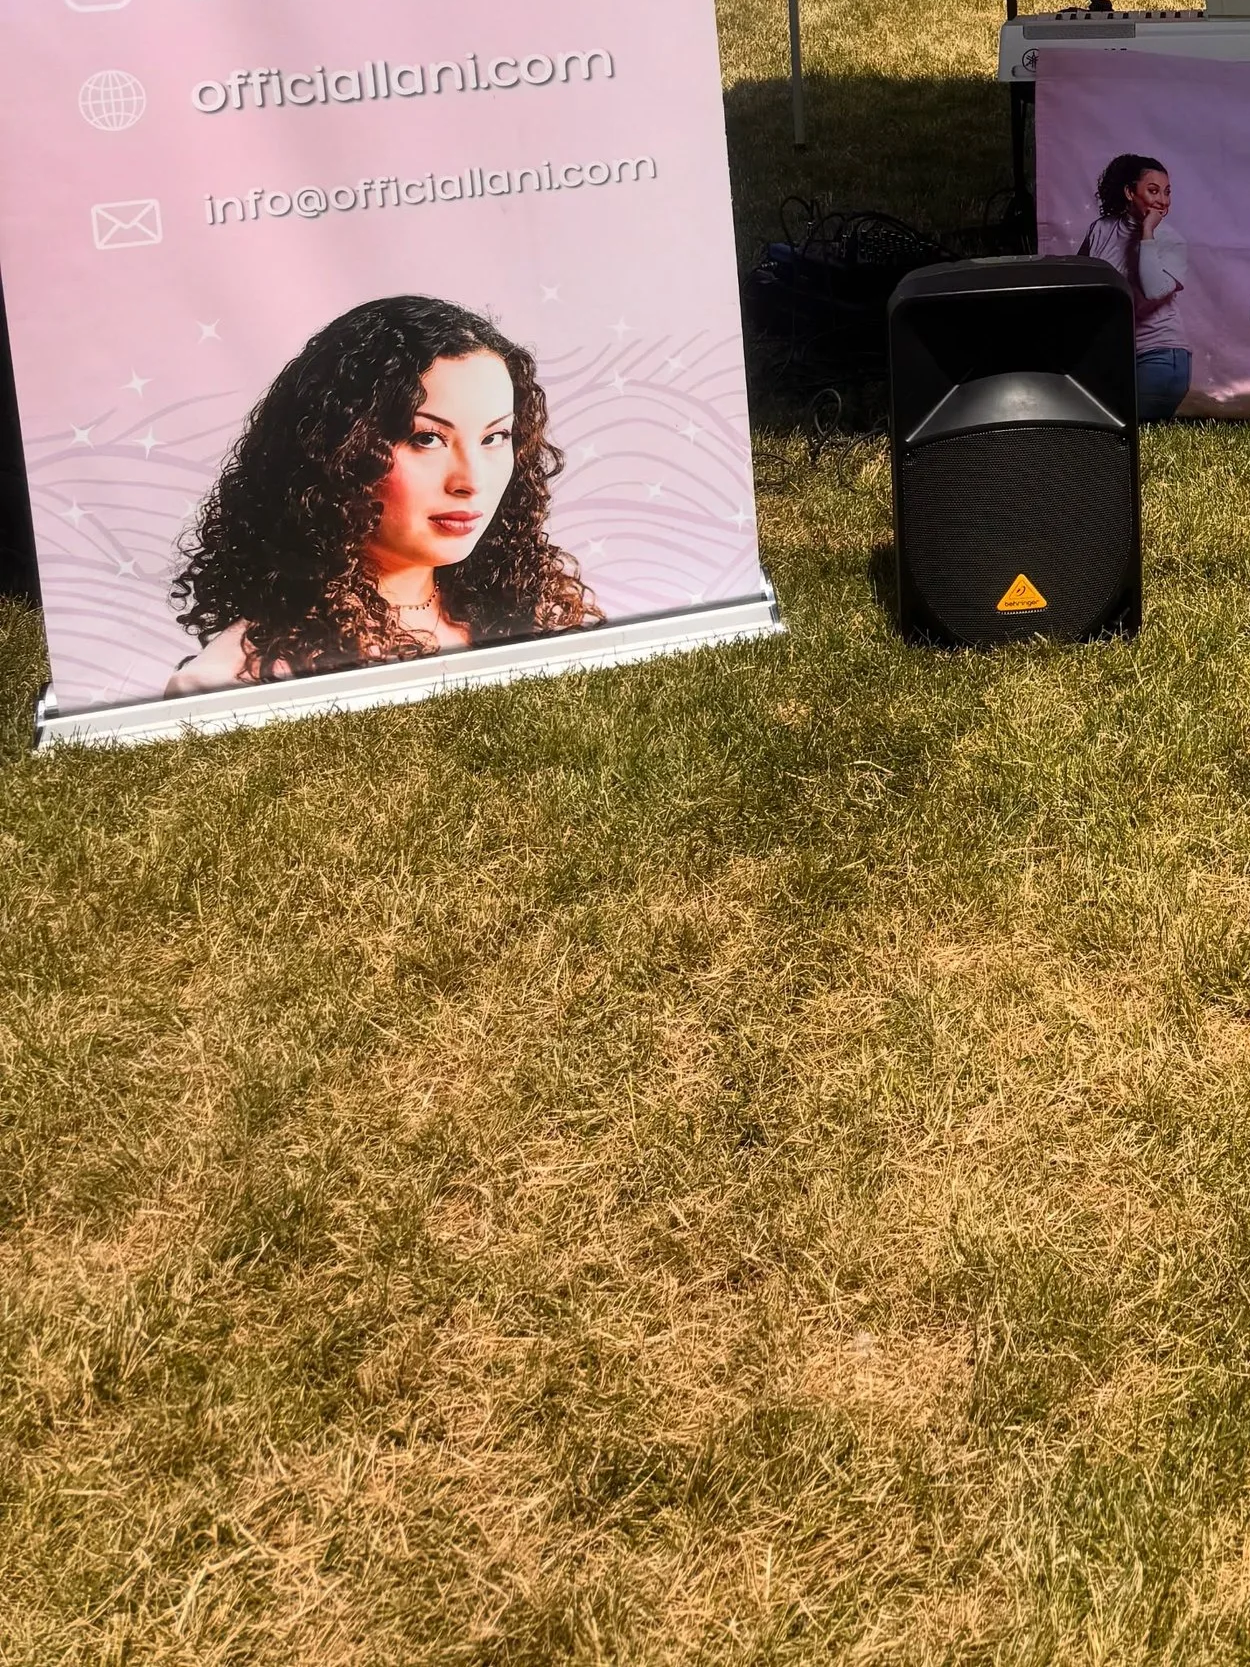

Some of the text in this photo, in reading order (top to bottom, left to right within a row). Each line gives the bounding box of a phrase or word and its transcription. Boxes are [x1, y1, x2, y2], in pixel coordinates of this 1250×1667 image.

[190, 42, 617, 118] officiallani.com
[202, 150, 659, 228] info@officiallani.com
[1004, 599, 1039, 607] behringer
